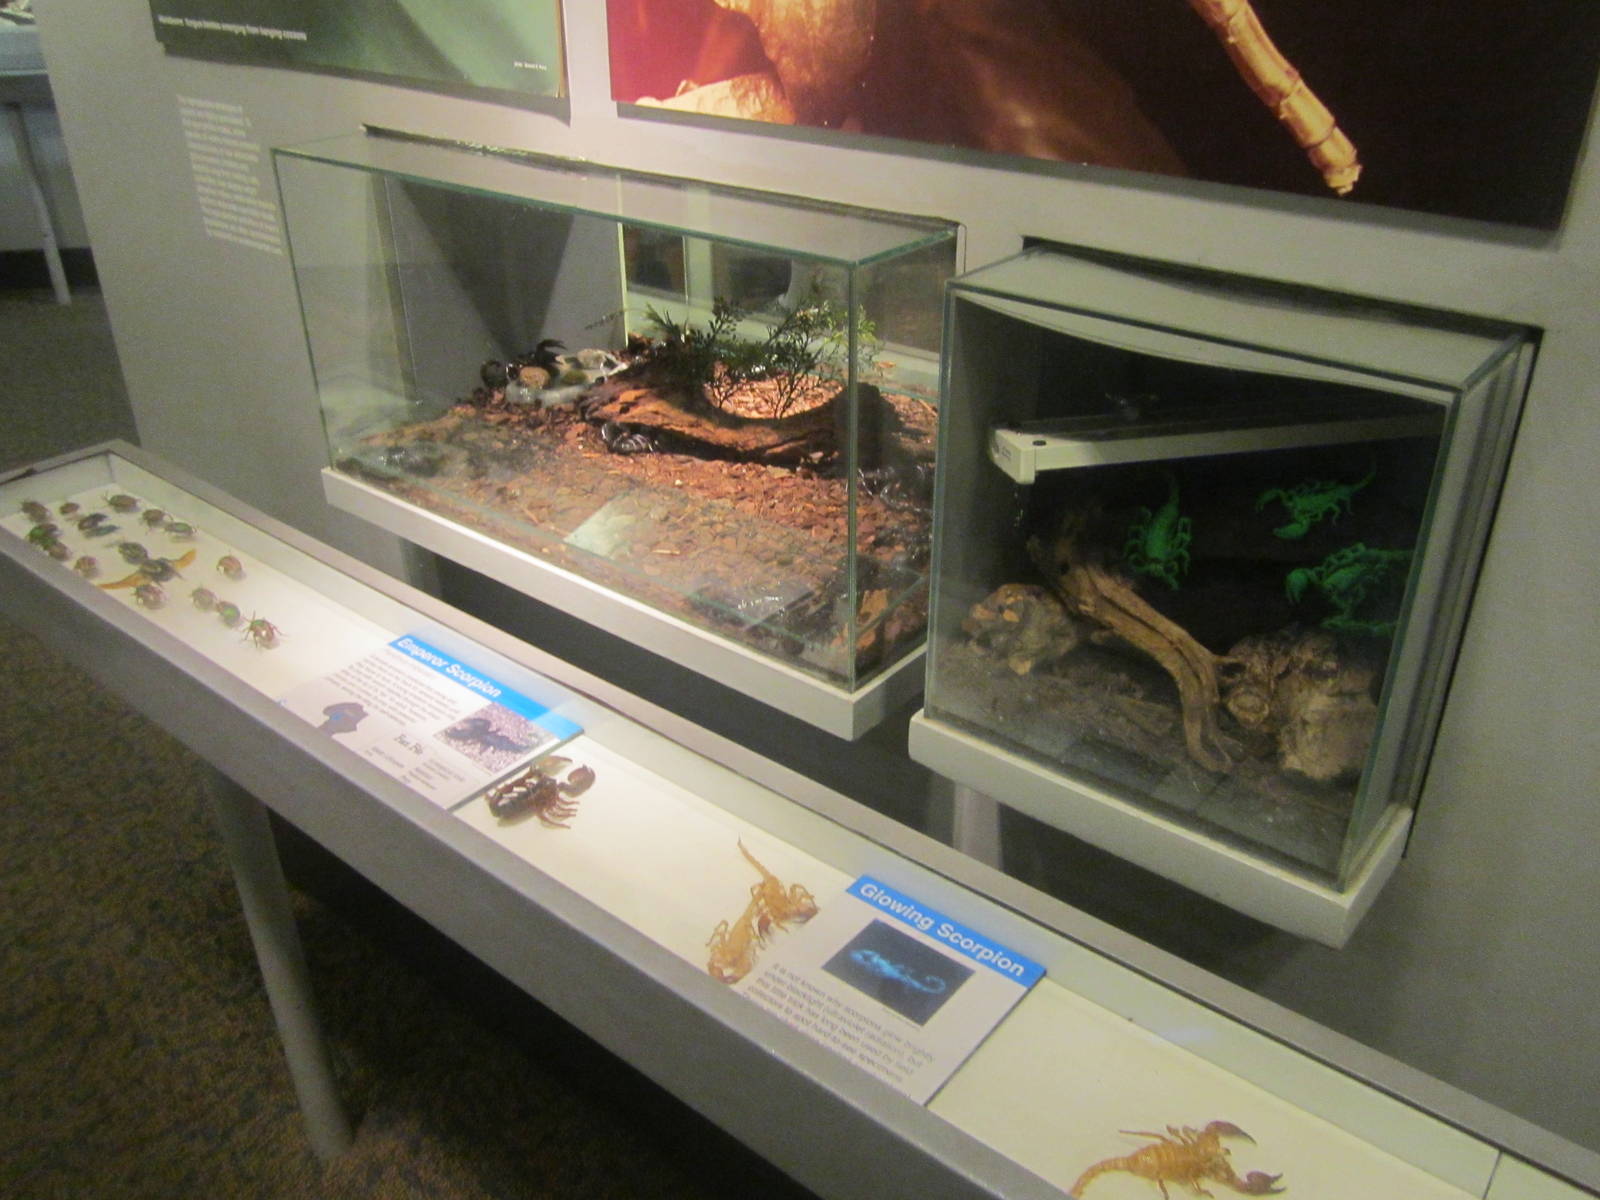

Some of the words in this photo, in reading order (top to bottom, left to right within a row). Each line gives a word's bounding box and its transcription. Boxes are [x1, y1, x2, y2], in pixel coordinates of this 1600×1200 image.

[397, 638, 448, 667] Emperor
[446, 663, 502, 698] Scorpion
[859, 883, 935, 930] Glowing
[936, 922, 1025, 976] Scorpion
